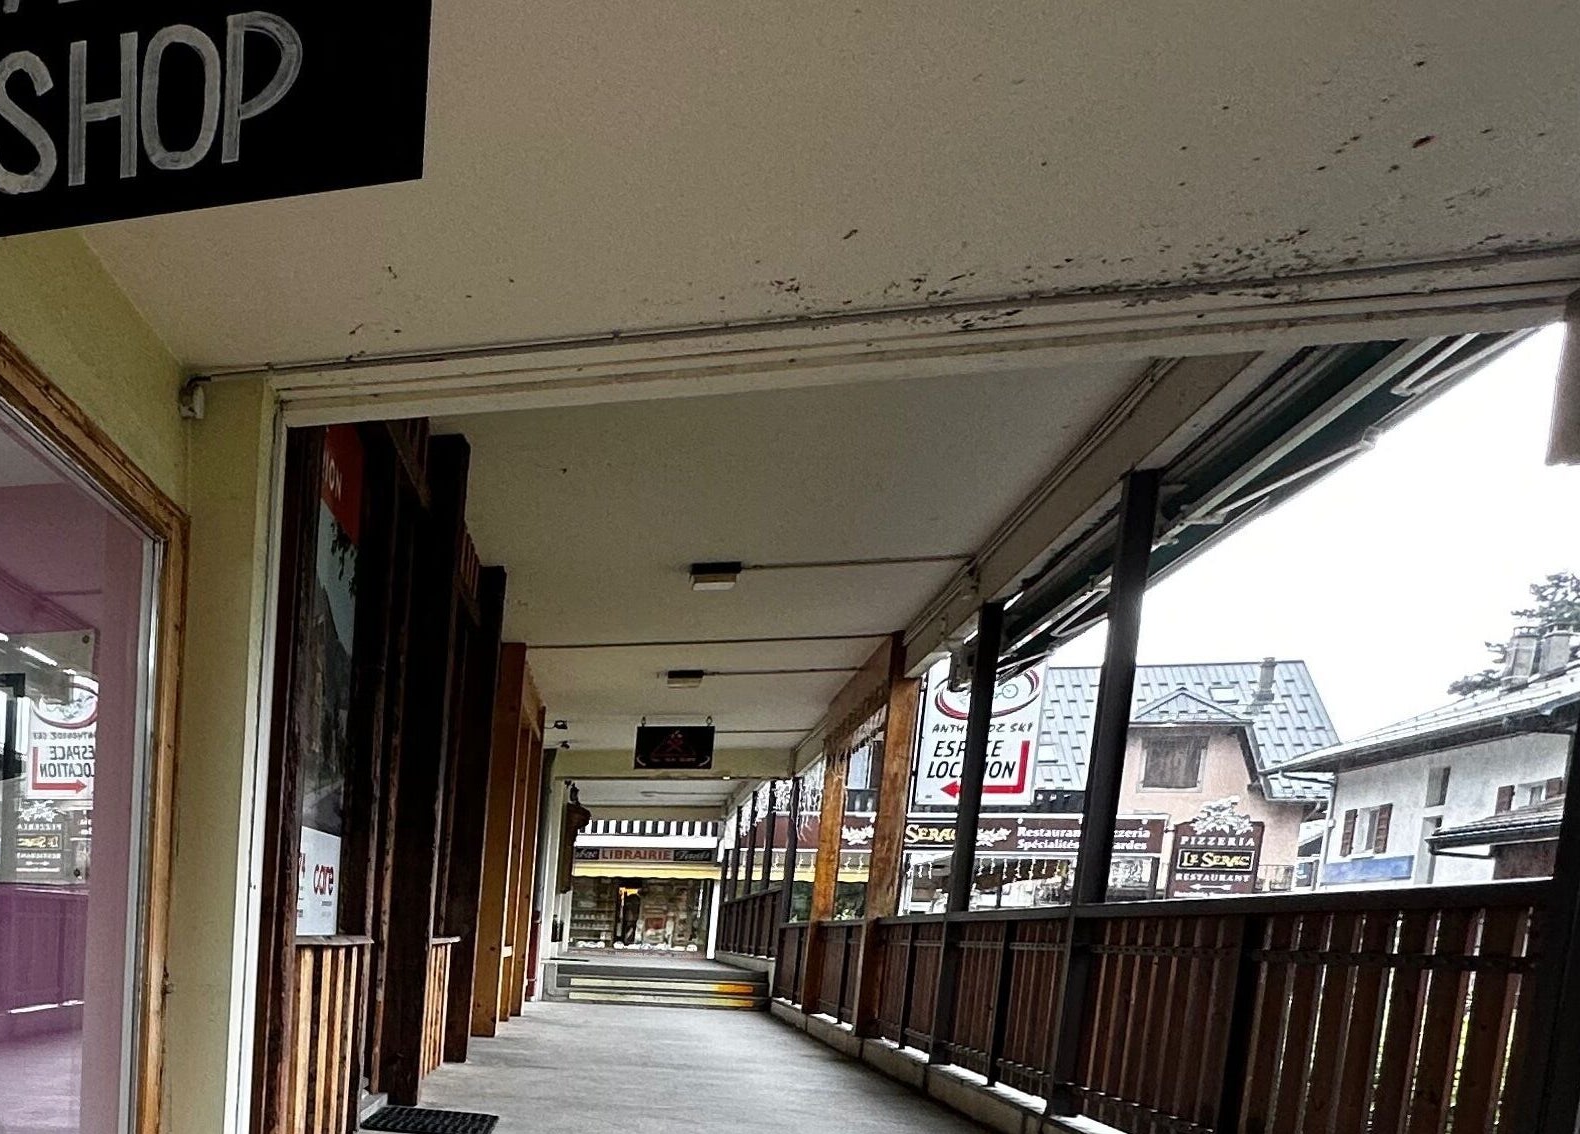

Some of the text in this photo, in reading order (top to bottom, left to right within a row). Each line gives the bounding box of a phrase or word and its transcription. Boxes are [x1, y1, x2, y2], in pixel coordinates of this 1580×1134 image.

[934, 740, 1004, 758] ESPE
[927, 761, 1017, 779] LOCON
[1180, 836, 1255, 846] PIZZERIA
[602, 849, 672, 860] LIBRAIRIE
[1176, 873, 1251, 882] RESTAURANT
